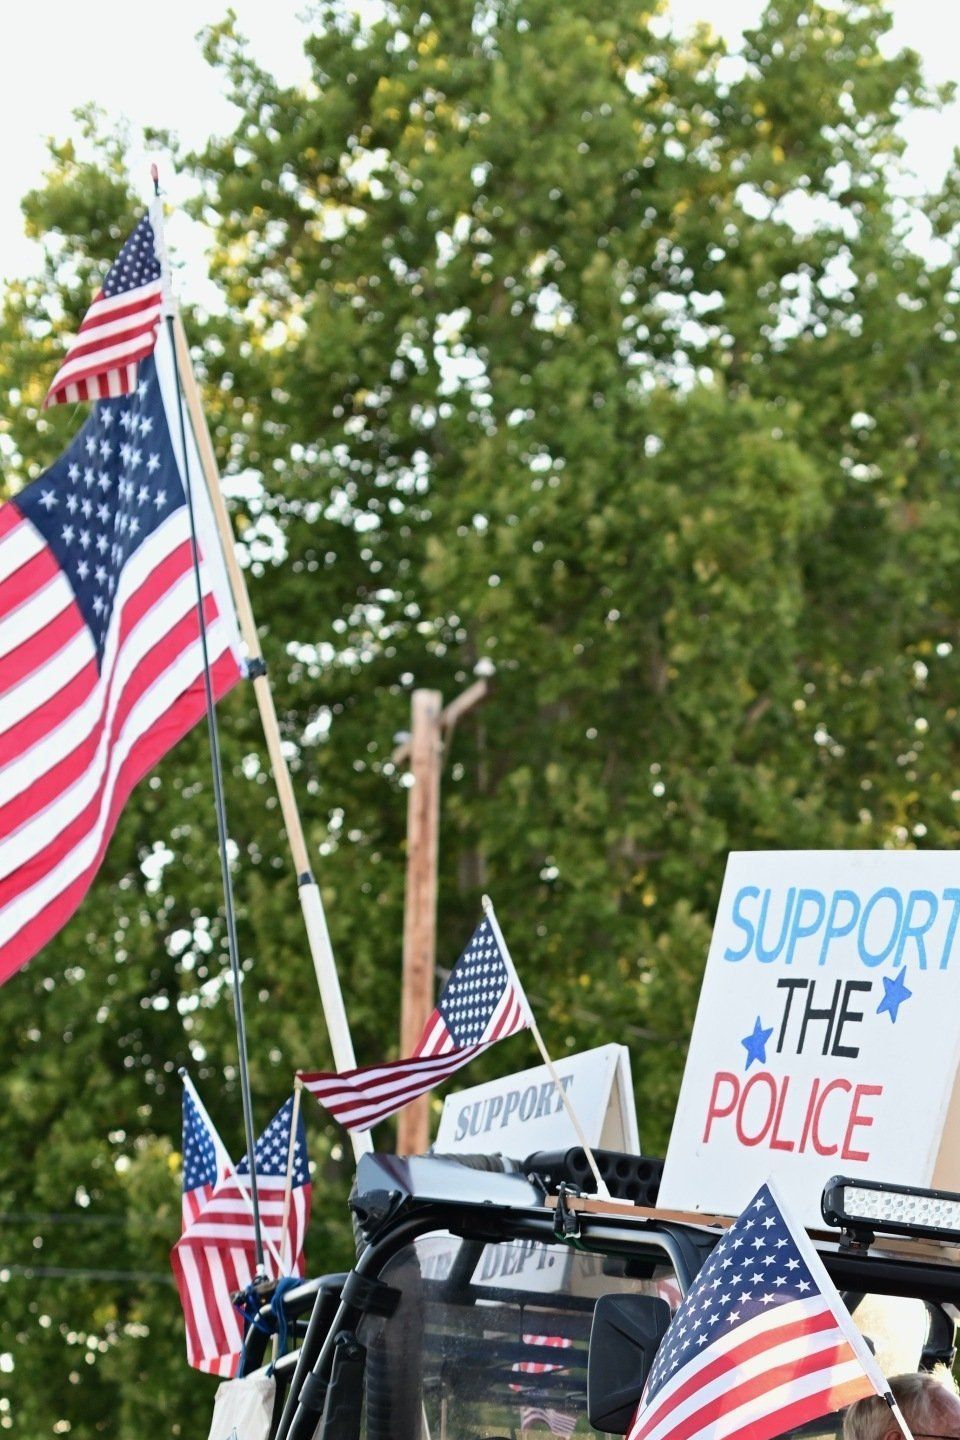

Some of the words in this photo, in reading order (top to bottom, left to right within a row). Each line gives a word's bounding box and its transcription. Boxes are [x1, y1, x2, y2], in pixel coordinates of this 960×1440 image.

[776, 978, 873, 1059] THE
[454, 1074, 574, 1142] SUPPORT
[702, 1071, 884, 1162] POLICE
